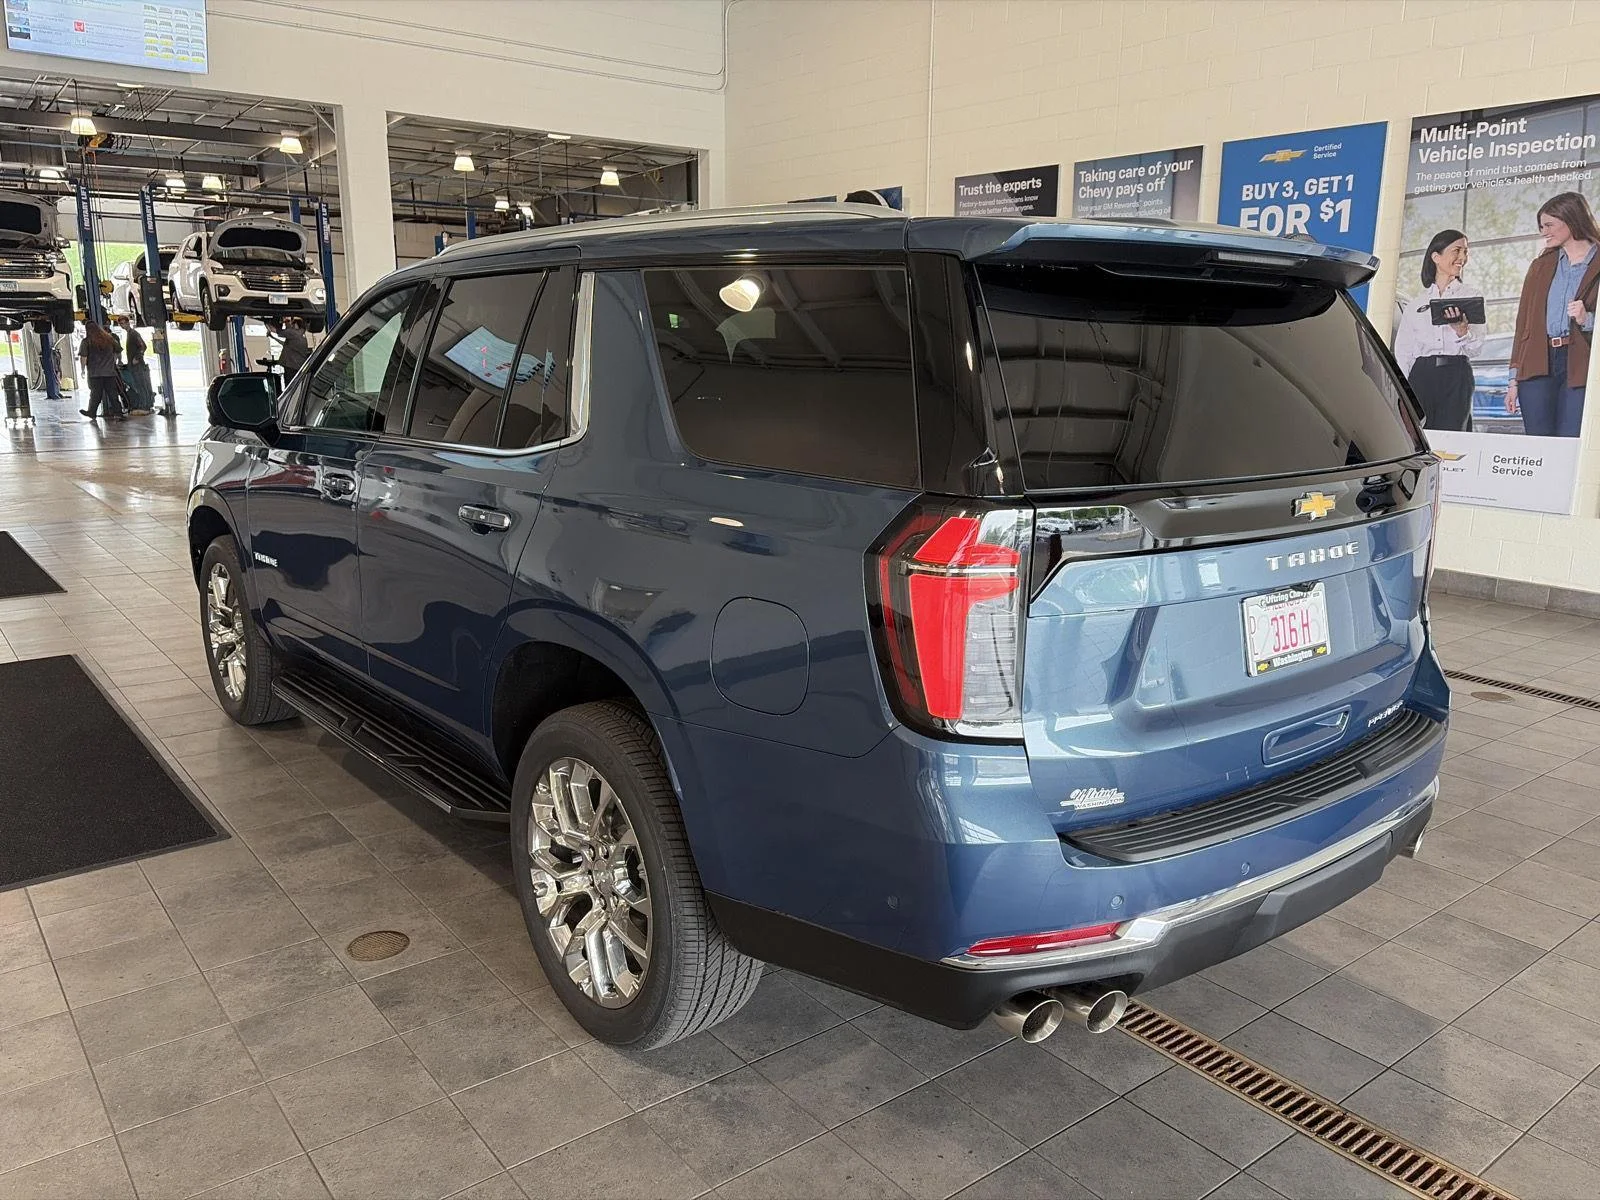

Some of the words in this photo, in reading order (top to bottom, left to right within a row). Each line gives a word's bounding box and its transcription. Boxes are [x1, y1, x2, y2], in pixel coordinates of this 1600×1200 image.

[1420, 117, 1528, 144] Multi-Point
[1313, 142, 1342, 152] Certified
[1313, 151, 1337, 160] Service
[1418, 143, 1484, 164] Vehicle
[1489, 132, 1596, 158] Inspection
[1078, 168, 1116, 183] Taking
[1118, 166, 1146, 179] care
[1147, 161, 1162, 176] of
[1164, 159, 1194, 177] your
[1415, 172, 1432, 182] The
[1434, 170, 1462, 182] peace
[1463, 168, 1474, 177] of
[1475, 165, 1500, 176] mind
[1502, 163, 1523, 174] that
[1524, 162, 1559, 172] comes
[1561, 158, 1587, 169] from
[958, 184, 984, 196] Trust
[985, 181, 1001, 194] the
[1003, 177, 1042, 193] experts
[1078, 186, 1114, 200] Chevy
[1115, 183, 1144, 198] pays
[1146, 177, 1167, 193] off
[1241, 181, 1280, 201] BUY
[1282, 180, 1300, 200] 3,
[1304, 175, 1343, 196] GET
[1344, 174, 1355, 192] 1
[1414, 183, 1447, 195] getting
[1448, 181, 1470, 192] your
[1471, 177, 1513, 189] vehicle's
[1513, 175, 1546, 186] health
[1547, 171, 1594, 182] checked.
[1239, 203, 1311, 238] FOR
[1319, 197, 1352, 233] $1
[1491, 465, 1534, 477] Service
[1492, 455, 1543, 467] Certified
[1265, 541, 1360, 571] TAHOE
[1270, 612, 1299, 653] 316
[1300, 608, 1311, 645] H
[1272, 649, 1313, 667] Washington
[1074, 797, 1125, 809] WASHINGTON
